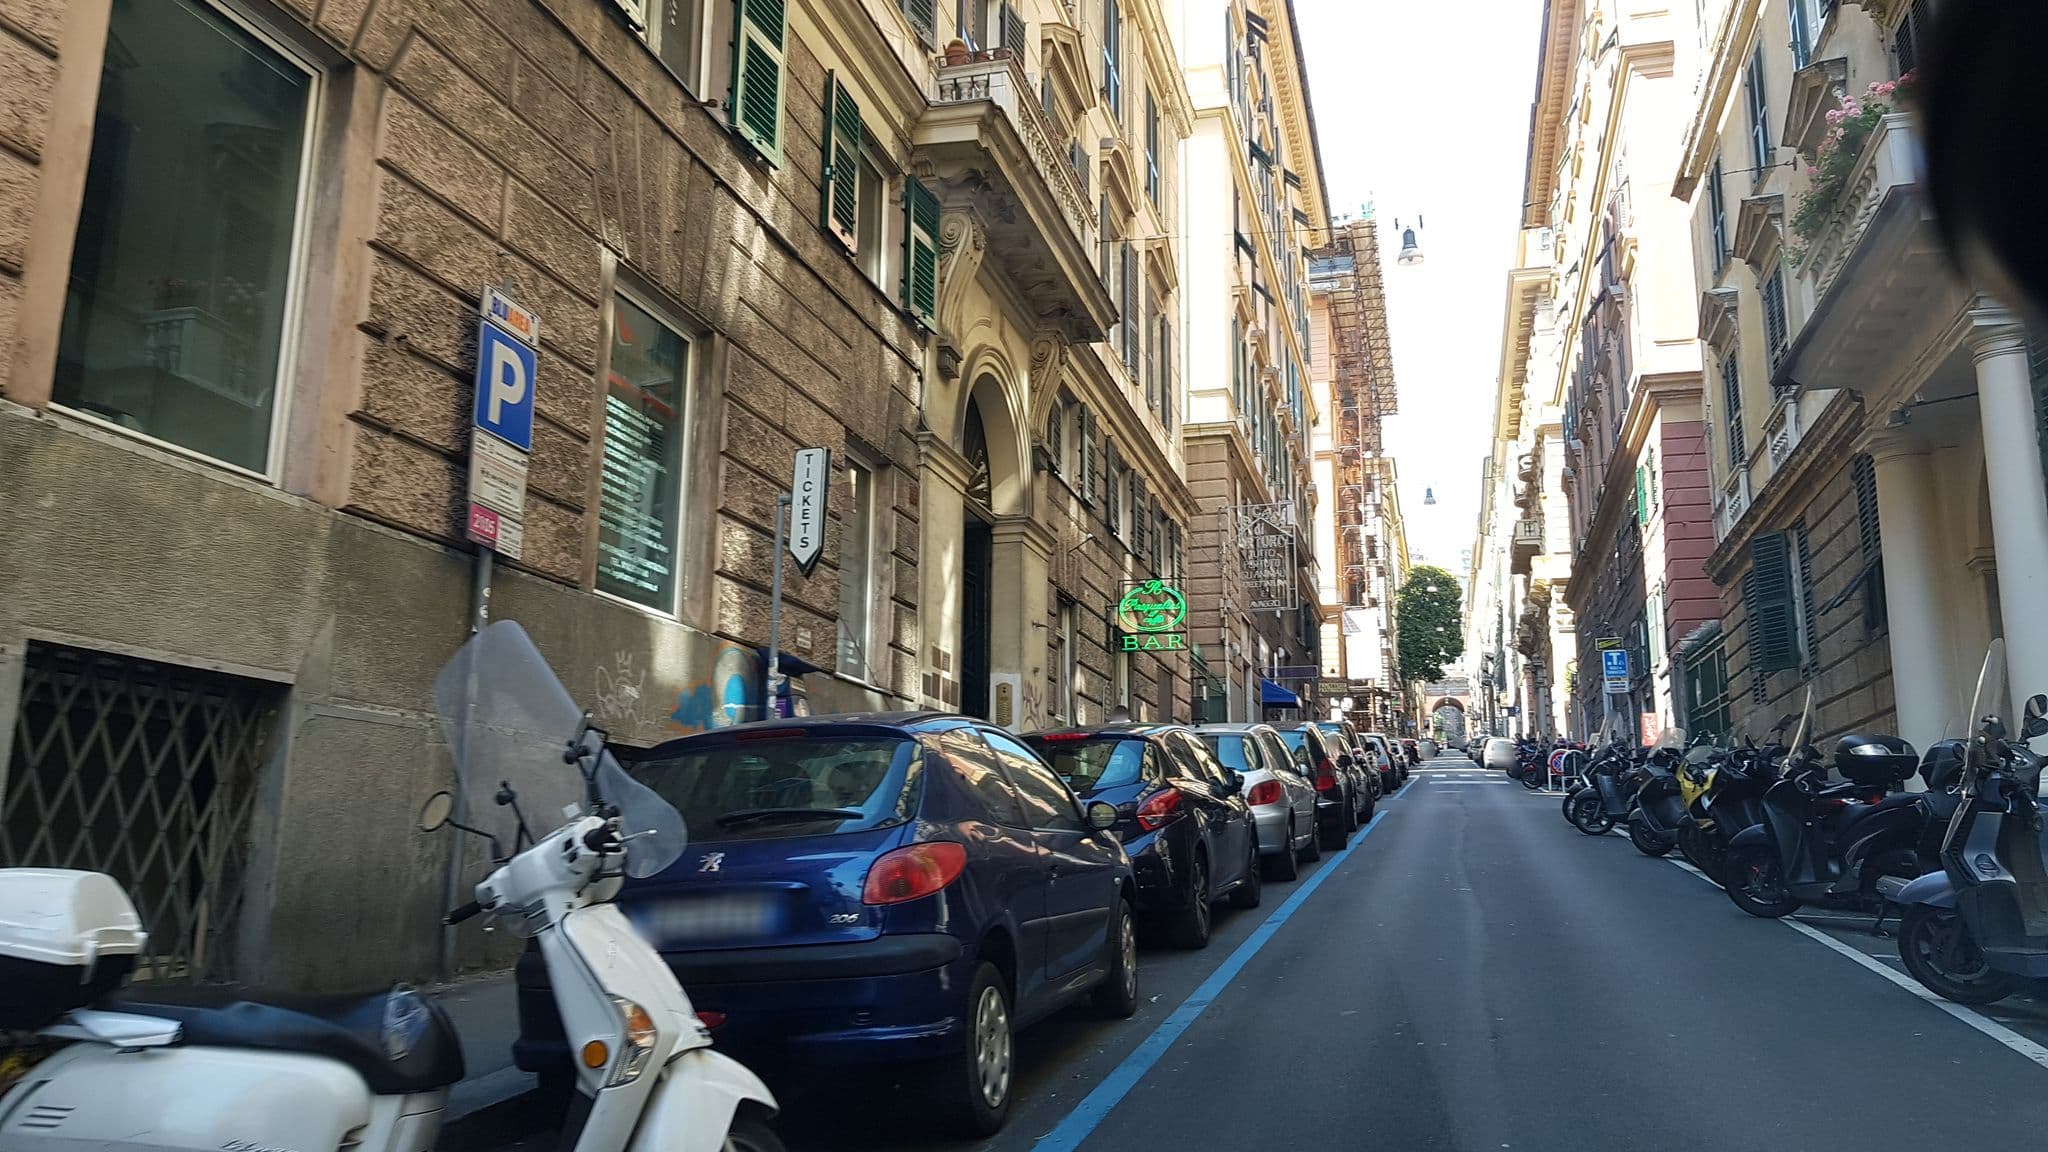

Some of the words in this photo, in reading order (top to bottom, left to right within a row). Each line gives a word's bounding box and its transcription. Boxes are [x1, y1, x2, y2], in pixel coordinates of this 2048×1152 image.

[488, 339, 526, 425] P
[799, 453, 814, 549] TICKETS
[1121, 633, 1185, 651] BAR
[830, 913, 860, 924] 206
